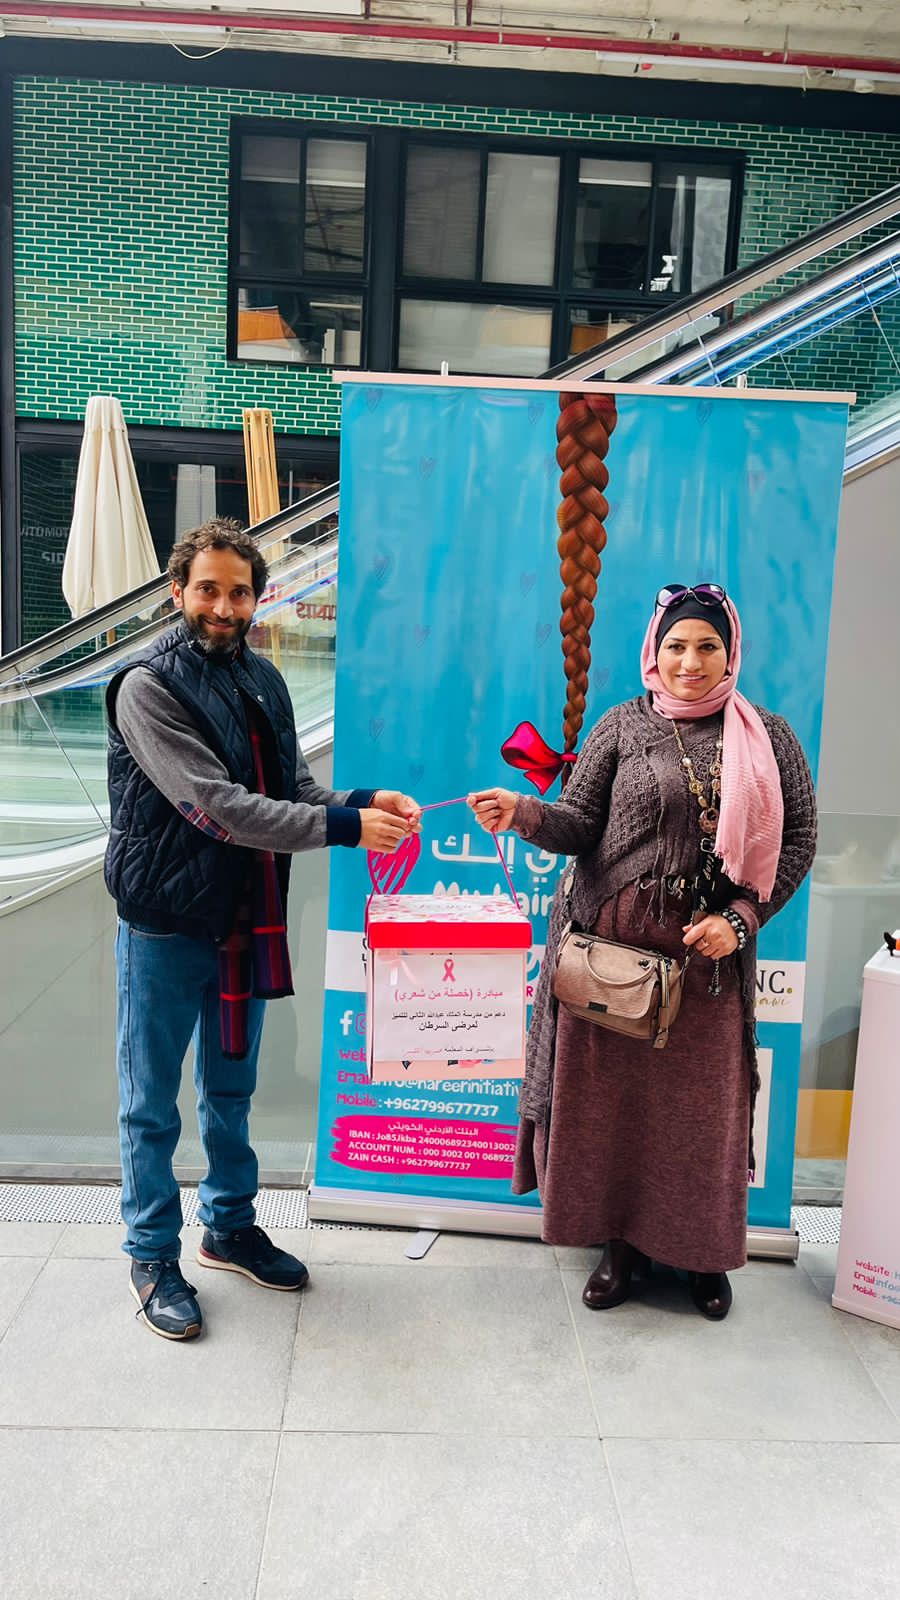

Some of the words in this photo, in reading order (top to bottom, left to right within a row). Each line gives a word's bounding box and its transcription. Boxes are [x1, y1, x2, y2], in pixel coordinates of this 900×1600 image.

[428, 990, 441, 1000] من
[419, 1021, 449, 1031] السرطان
[384, 1097, 499, 1117] +962799677737
[349, 1129, 371, 1140] IBAN
[348, 1141, 391, 1153] ACCOUNT
[423, 1147, 440, 1157] 000
[441, 1149, 463, 1159] 3002
[464, 1151, 480, 1160] 001
[348, 1152, 369, 1162] ZAIN
[370, 1154, 395, 1165] CASH
